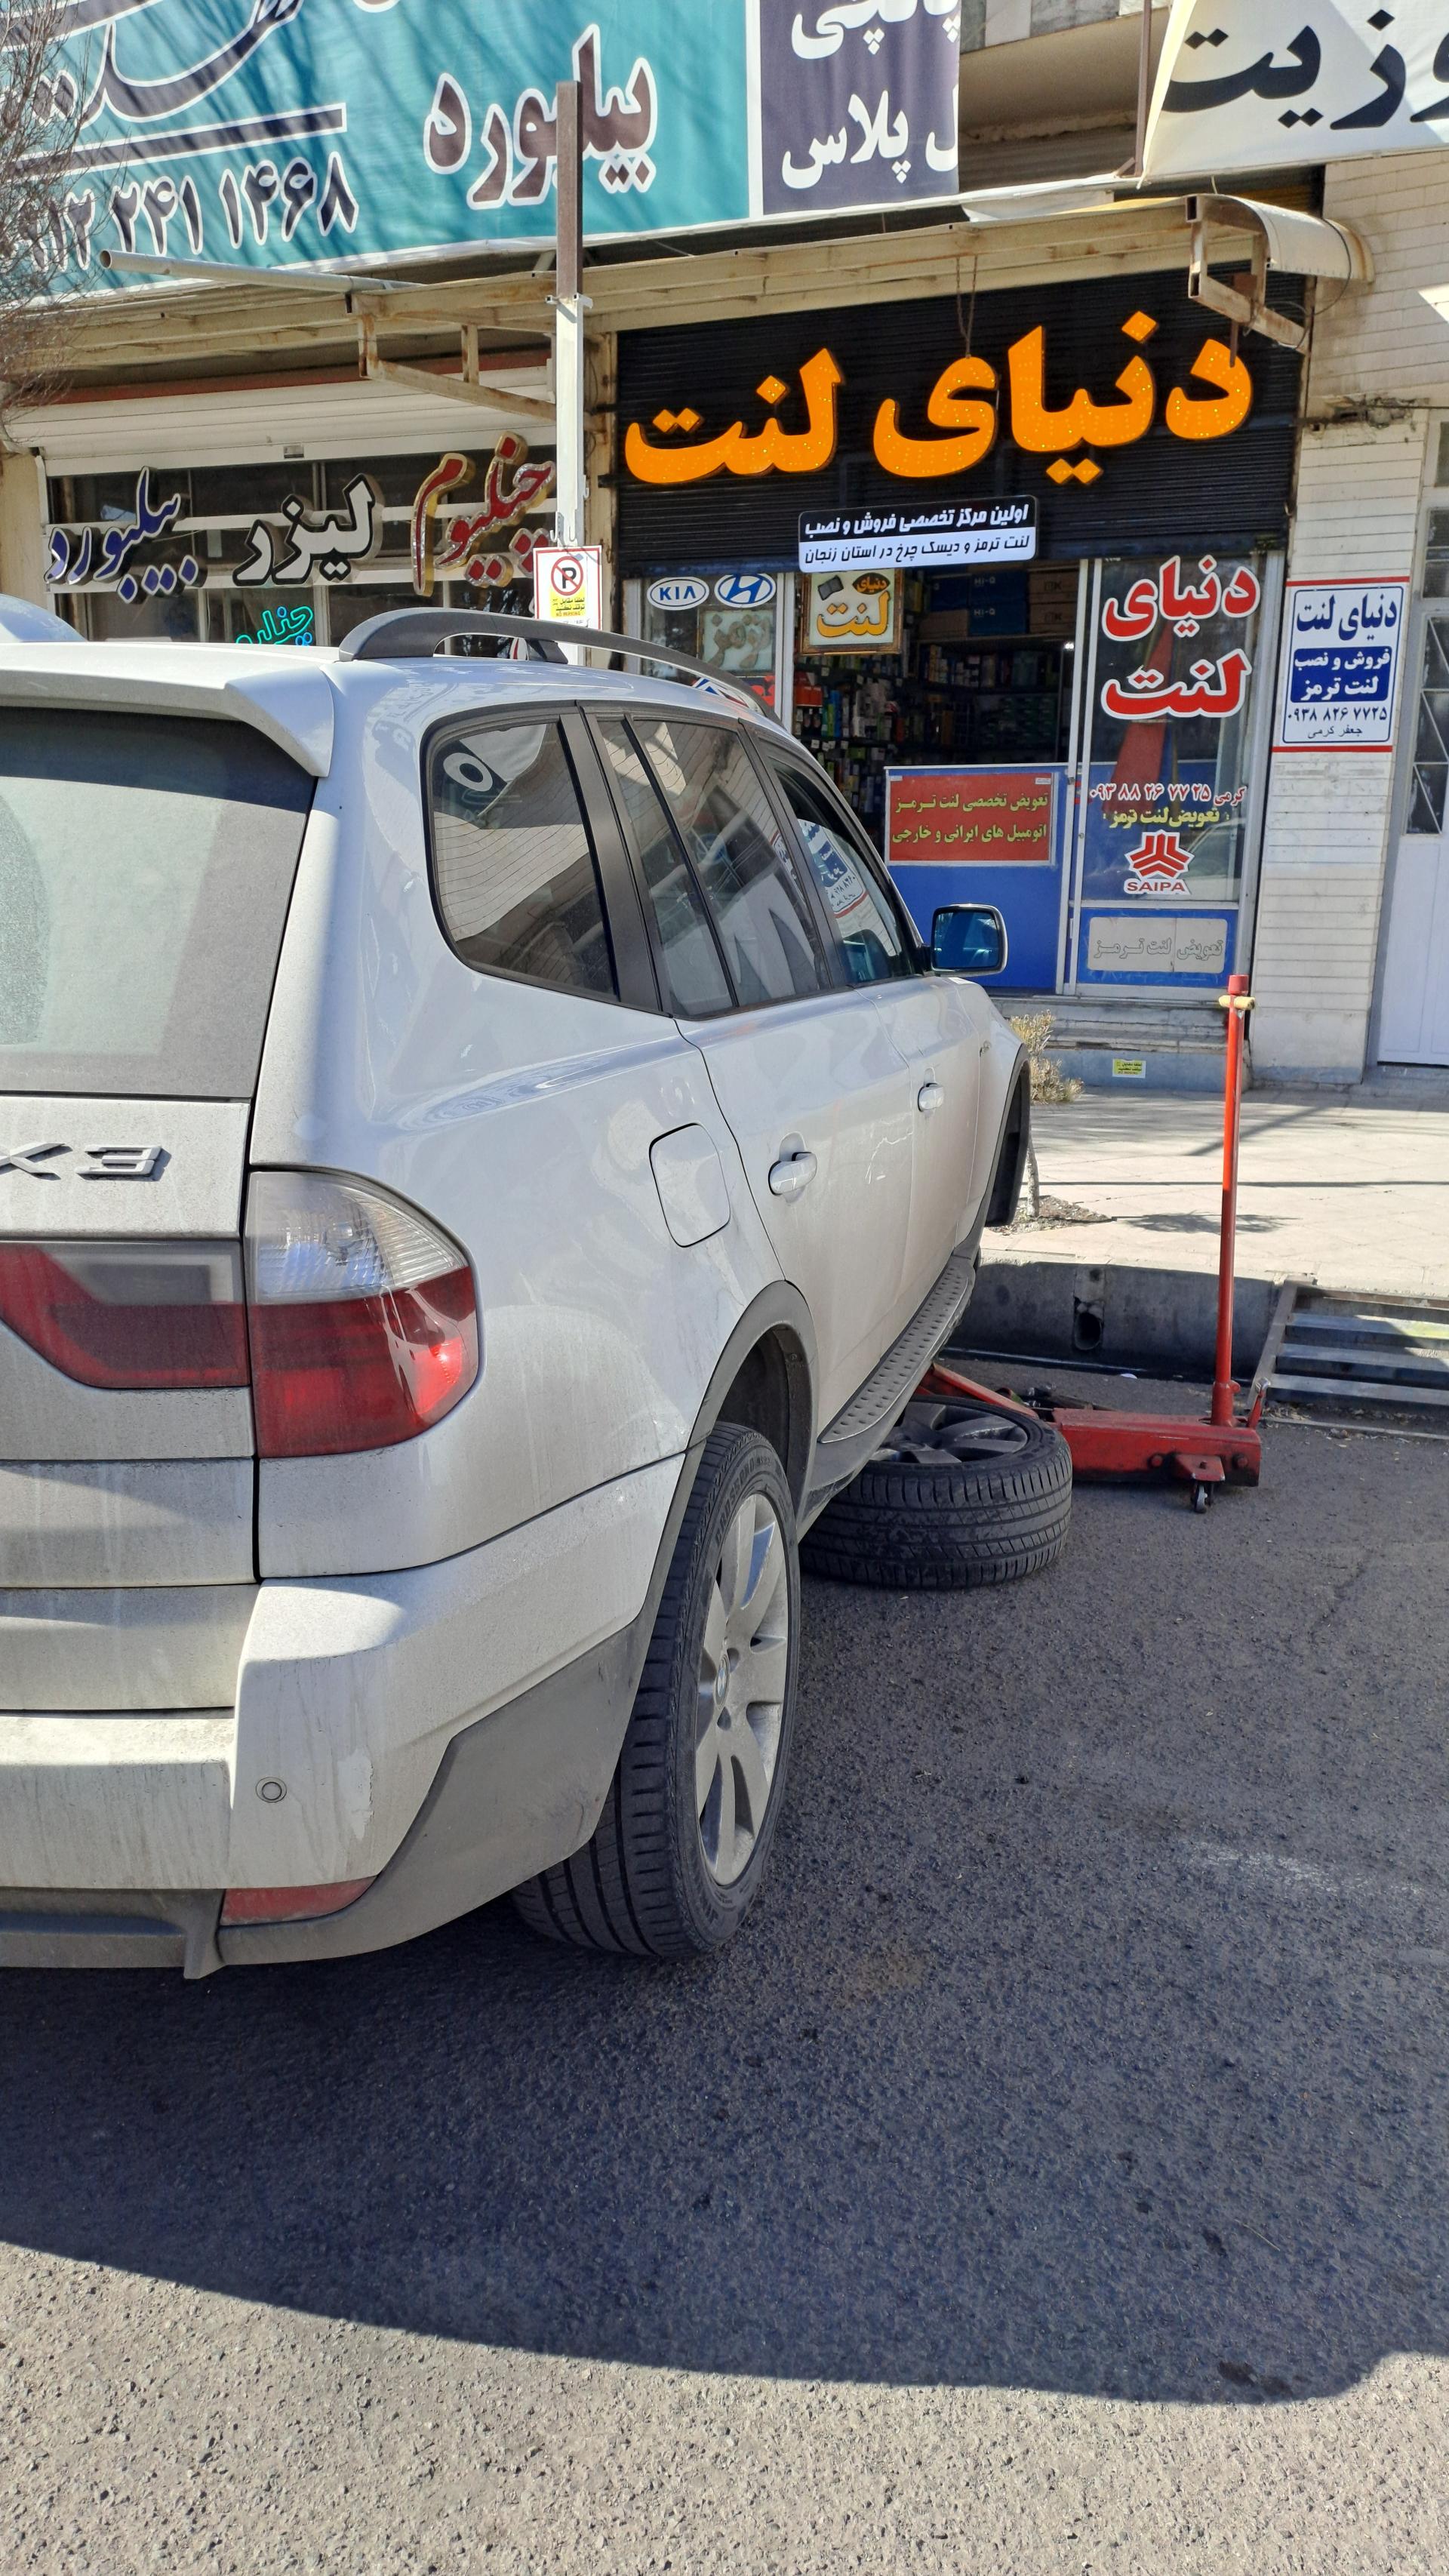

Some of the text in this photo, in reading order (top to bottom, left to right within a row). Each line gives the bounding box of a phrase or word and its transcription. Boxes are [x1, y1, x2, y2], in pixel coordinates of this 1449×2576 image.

[423, 23, 657, 211] بیلوره
[782, 90, 910, 189] پلاس
[109, 175, 204, 254] ۲۴۱
[219, 151, 358, 250] ۱۴۶۸
[624, 311, 1253, 485] دنیای لنت
[232, 473, 375, 586] لیزر
[804, 503, 1029, 538] اولین مرکز تخصصی فروش و نصب
[44, 466, 198, 603] بیلبورد
[804, 535, 1029, 565] لنت ترمز و دیسک چرخ در استان زنجان
[659, 586, 697, 601] KIA
[856, 574, 888, 593] دنیای
[1102, 555, 1260, 642] دنیای
[817, 590, 891, 638] لنت
[1297, 593, 1398, 641] دنیای لنت
[1294, 648, 1391, 671] فروش و نصب
[1101, 648, 1253, 719] لنت
[1300, 676, 1379, 700] لنت ترمز
[1287, 706, 1387, 722] ۰۹۳۸ ۸۲۶ ۷۷۲۵
[1308, 725, 1363, 739] جعفر کرمی
[895, 792, 1048, 813] تعویض تخصصی لنت ترمز
[1118, 783, 1141, 802] ۸۸
[1144, 783, 1164, 801] ۲۶
[1168, 783, 1189, 802] ۷۷
[1192, 783, 1211, 802] ۲۵
[1214, 786, 1247, 806] کرمی
[1109, 806, 1220, 829] تعویض لنت ترمز
[892, 823, 1048, 843] اتومبیل های ایرانی و خارجی
[1127, 882, 1186, 891] SAIPA
[1094, 937, 1224, 961] تعویض لنت ترمز
